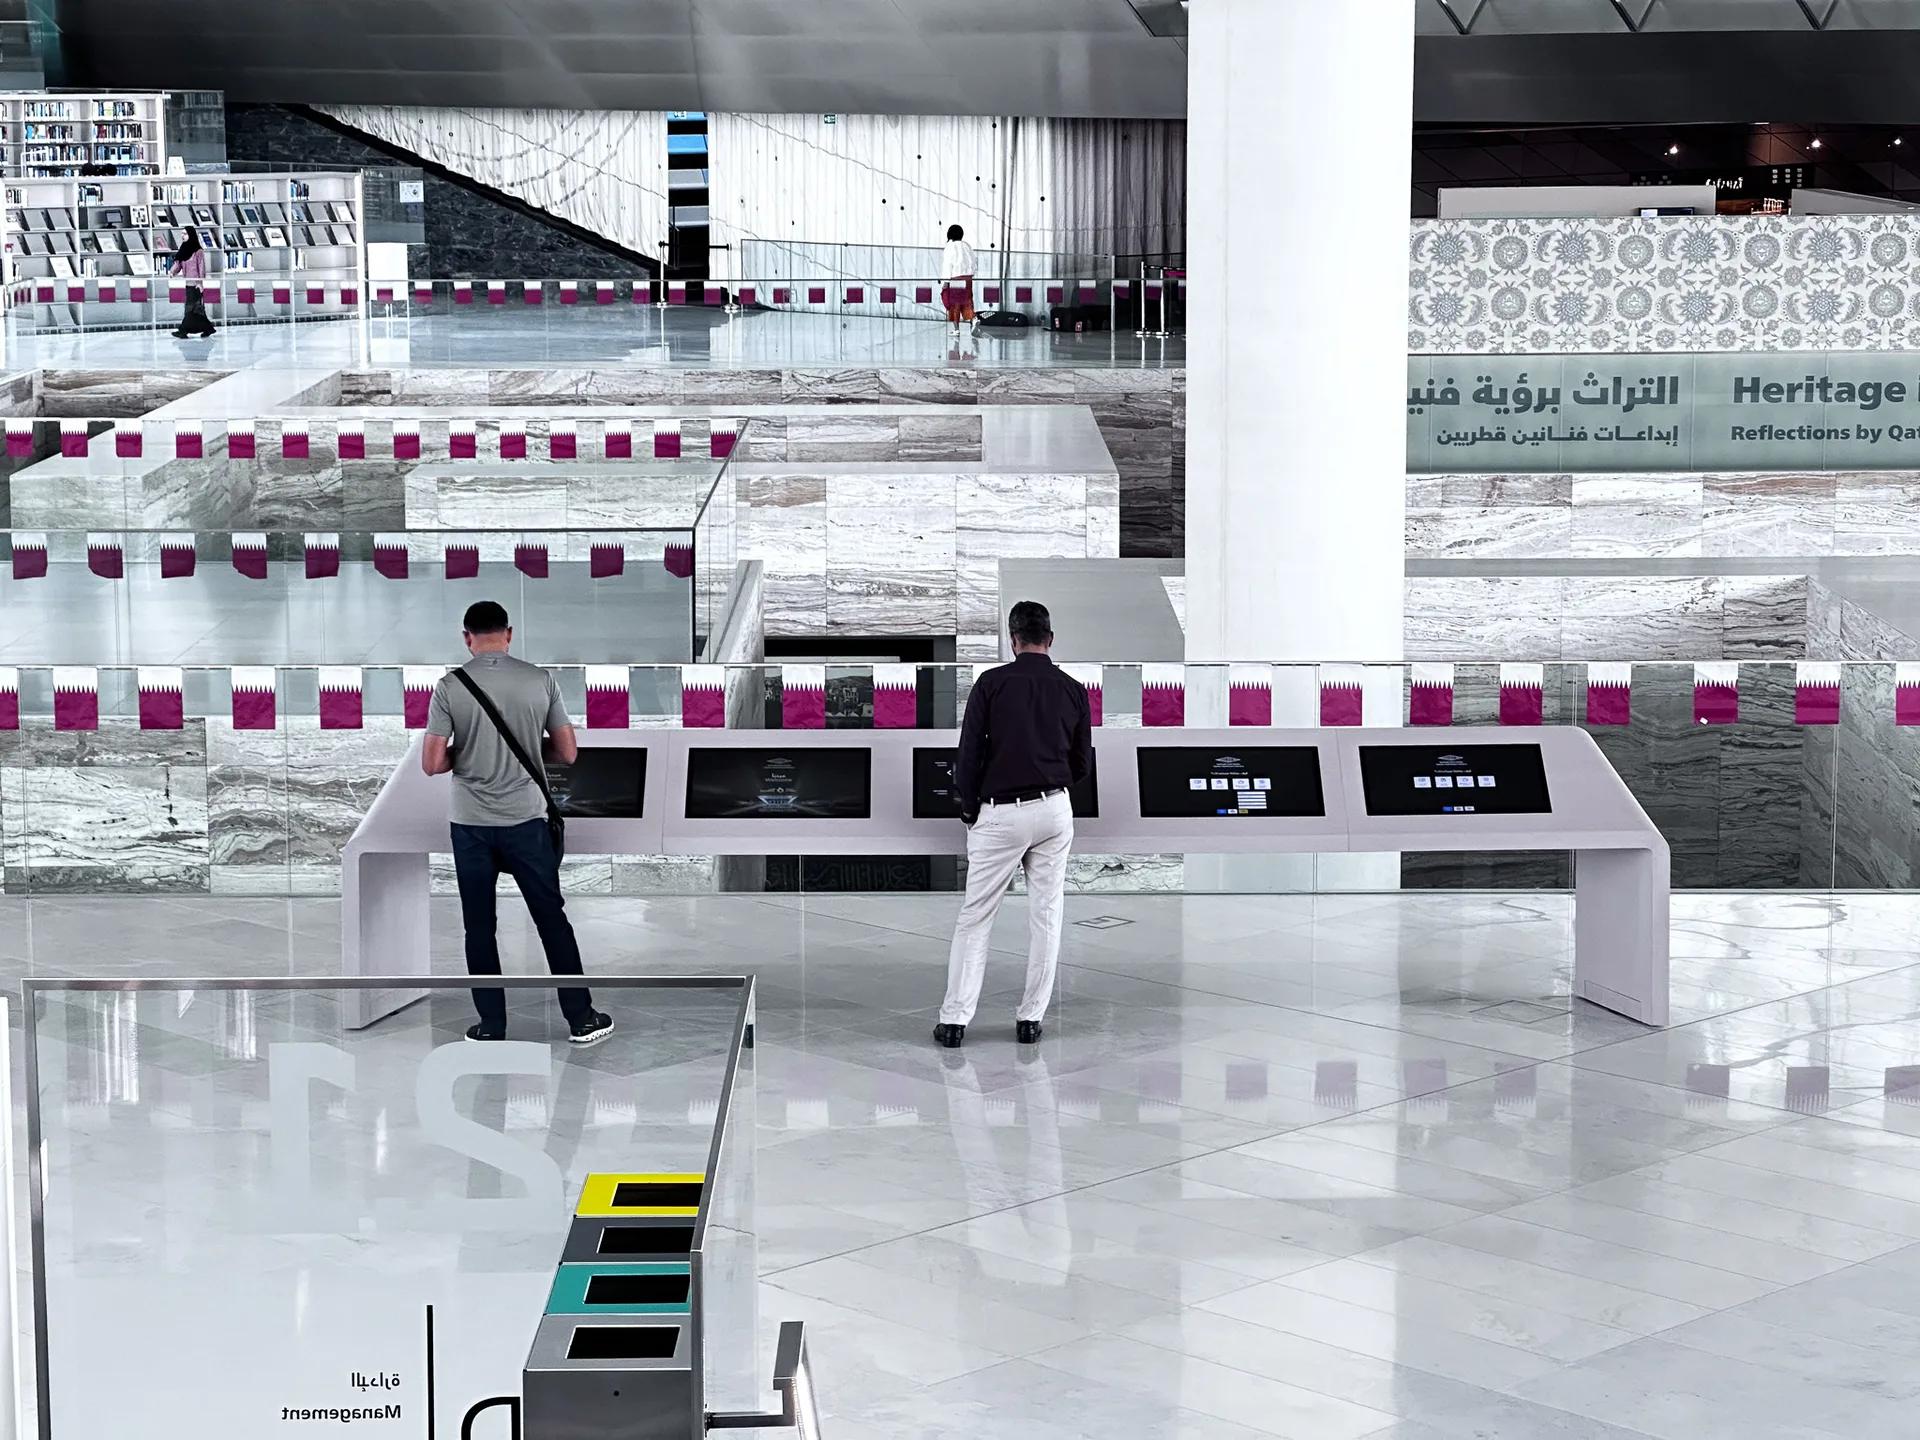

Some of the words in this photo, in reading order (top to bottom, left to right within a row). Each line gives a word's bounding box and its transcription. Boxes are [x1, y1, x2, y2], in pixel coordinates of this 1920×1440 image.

[1407, 378, 1460, 415] فني
[1472, 372, 1561, 415] برؤية
[1572, 372, 1679, 413] التراث
[1733, 375, 1907, 411] Heritage
[1436, 426, 1507, 447] قطريين
[1731, 424, 1851, 441] Reflections
[1856, 423, 1883, 444] by
